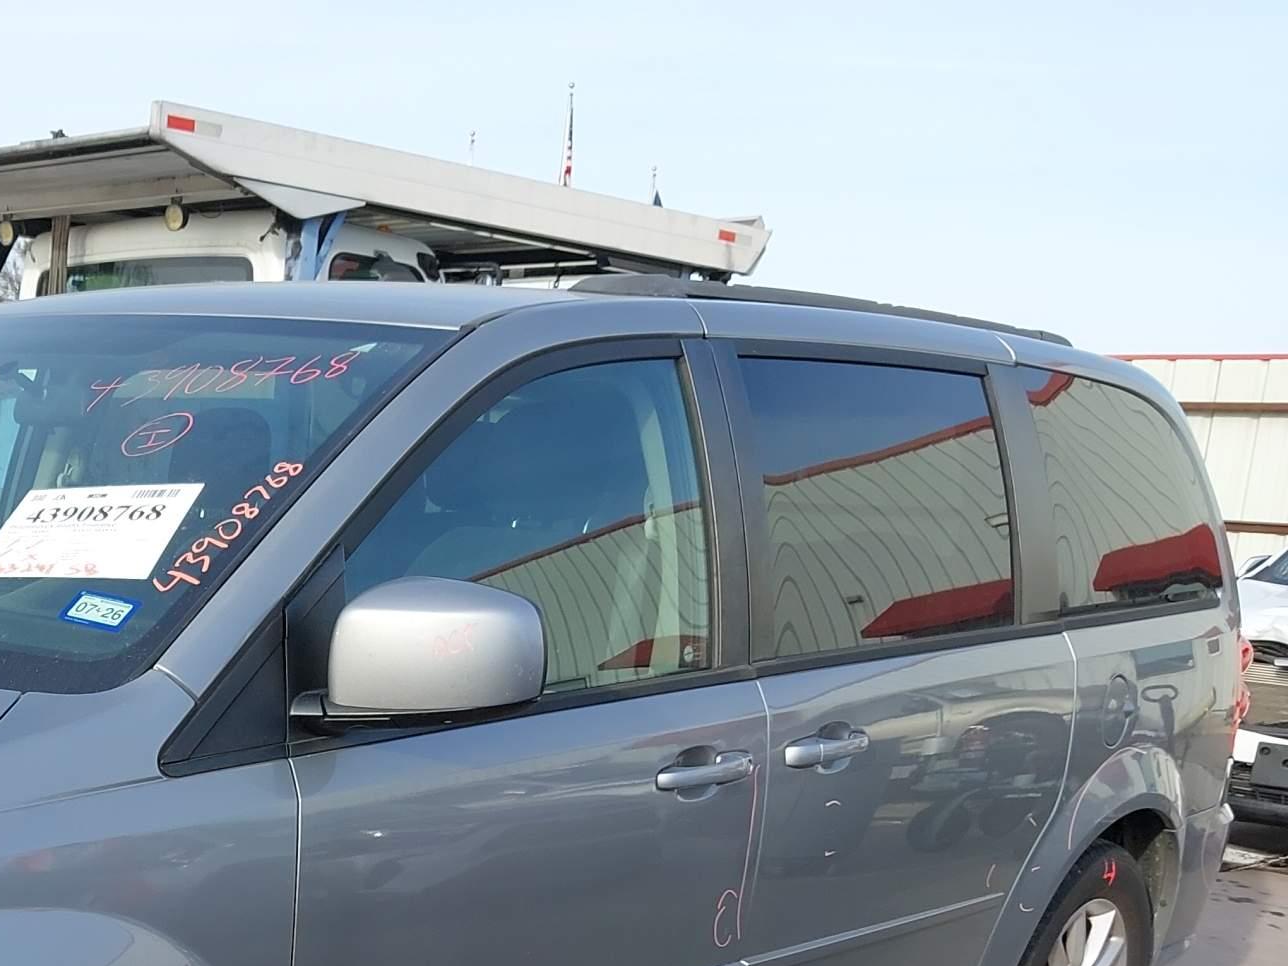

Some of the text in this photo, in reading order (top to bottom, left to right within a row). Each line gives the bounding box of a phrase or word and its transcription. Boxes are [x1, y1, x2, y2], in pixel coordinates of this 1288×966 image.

[87, 351, 360, 412] 43908768
[26, 504, 167, 524] 43908768
[152, 461, 304, 592] 43908768
[75, 602, 98, 615] 07
[100, 608, 124, 621] 26
